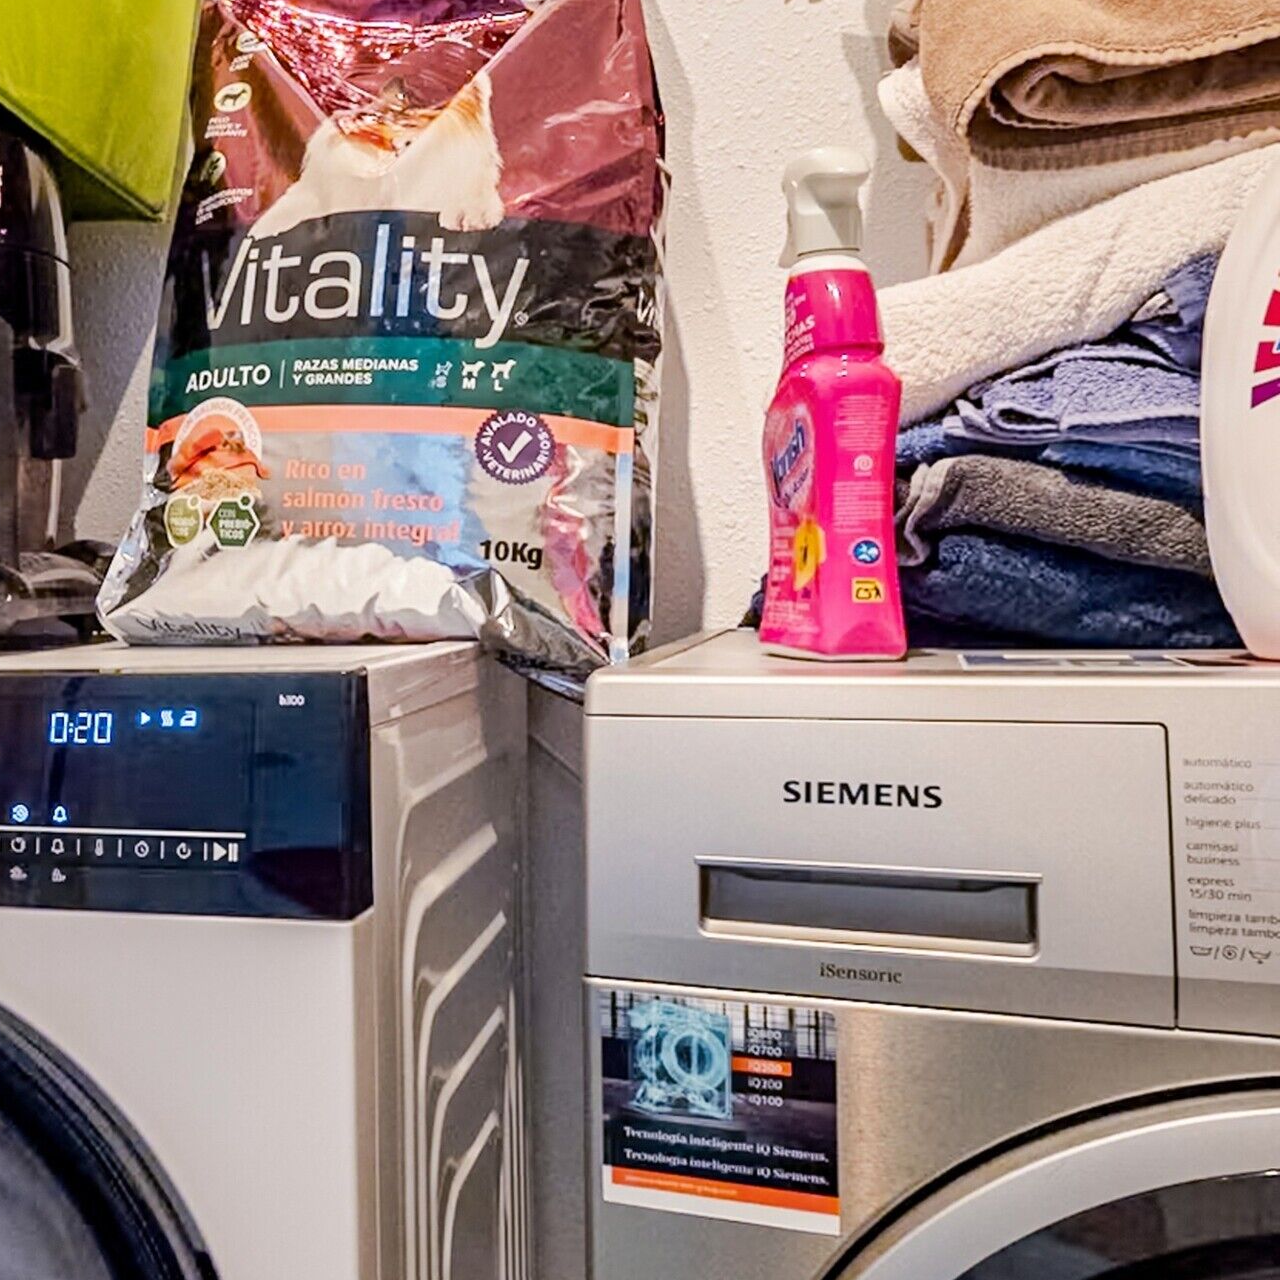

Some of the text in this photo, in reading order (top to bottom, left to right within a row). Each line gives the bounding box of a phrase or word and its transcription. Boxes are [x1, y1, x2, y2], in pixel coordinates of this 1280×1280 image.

[202, 224, 530, 349] Vitality
[293, 358, 419, 372] RAZAS MEDIANAS
[185, 363, 271, 394] ADULTO
[293, 372, 373, 386] Y GRANDES
[462, 376, 476, 390] M
[493, 378, 504, 392] L
[480, 412, 537, 447] AVALADO
[482, 431, 552, 480] VETERINARIOS
[284, 458, 367, 481] Rico en
[372, 488, 444, 512] fresco
[281, 519, 462, 547] y arroz integral
[479, 540, 544, 570] 10Kg
[50, 711, 113, 744] 0:20
[783, 780, 943, 808] SIEMENS
[1183, 793, 1236, 805] delicado
[1185, 817, 1262, 832] higiene plus
[1186, 854, 1241, 867] business
[1187, 876, 1235, 888] express
[1189, 888, 1252, 902] 15/30 min
[1188, 909, 1241, 926] limpieza
[819, 961, 904, 985] iSensoric
[747, 1044, 783, 1057] iQ700
[689, 1133, 754, 1154] inteligente
[772, 1145, 830, 1163] Siemens.
[772, 1169, 830, 1186] Siemens.
